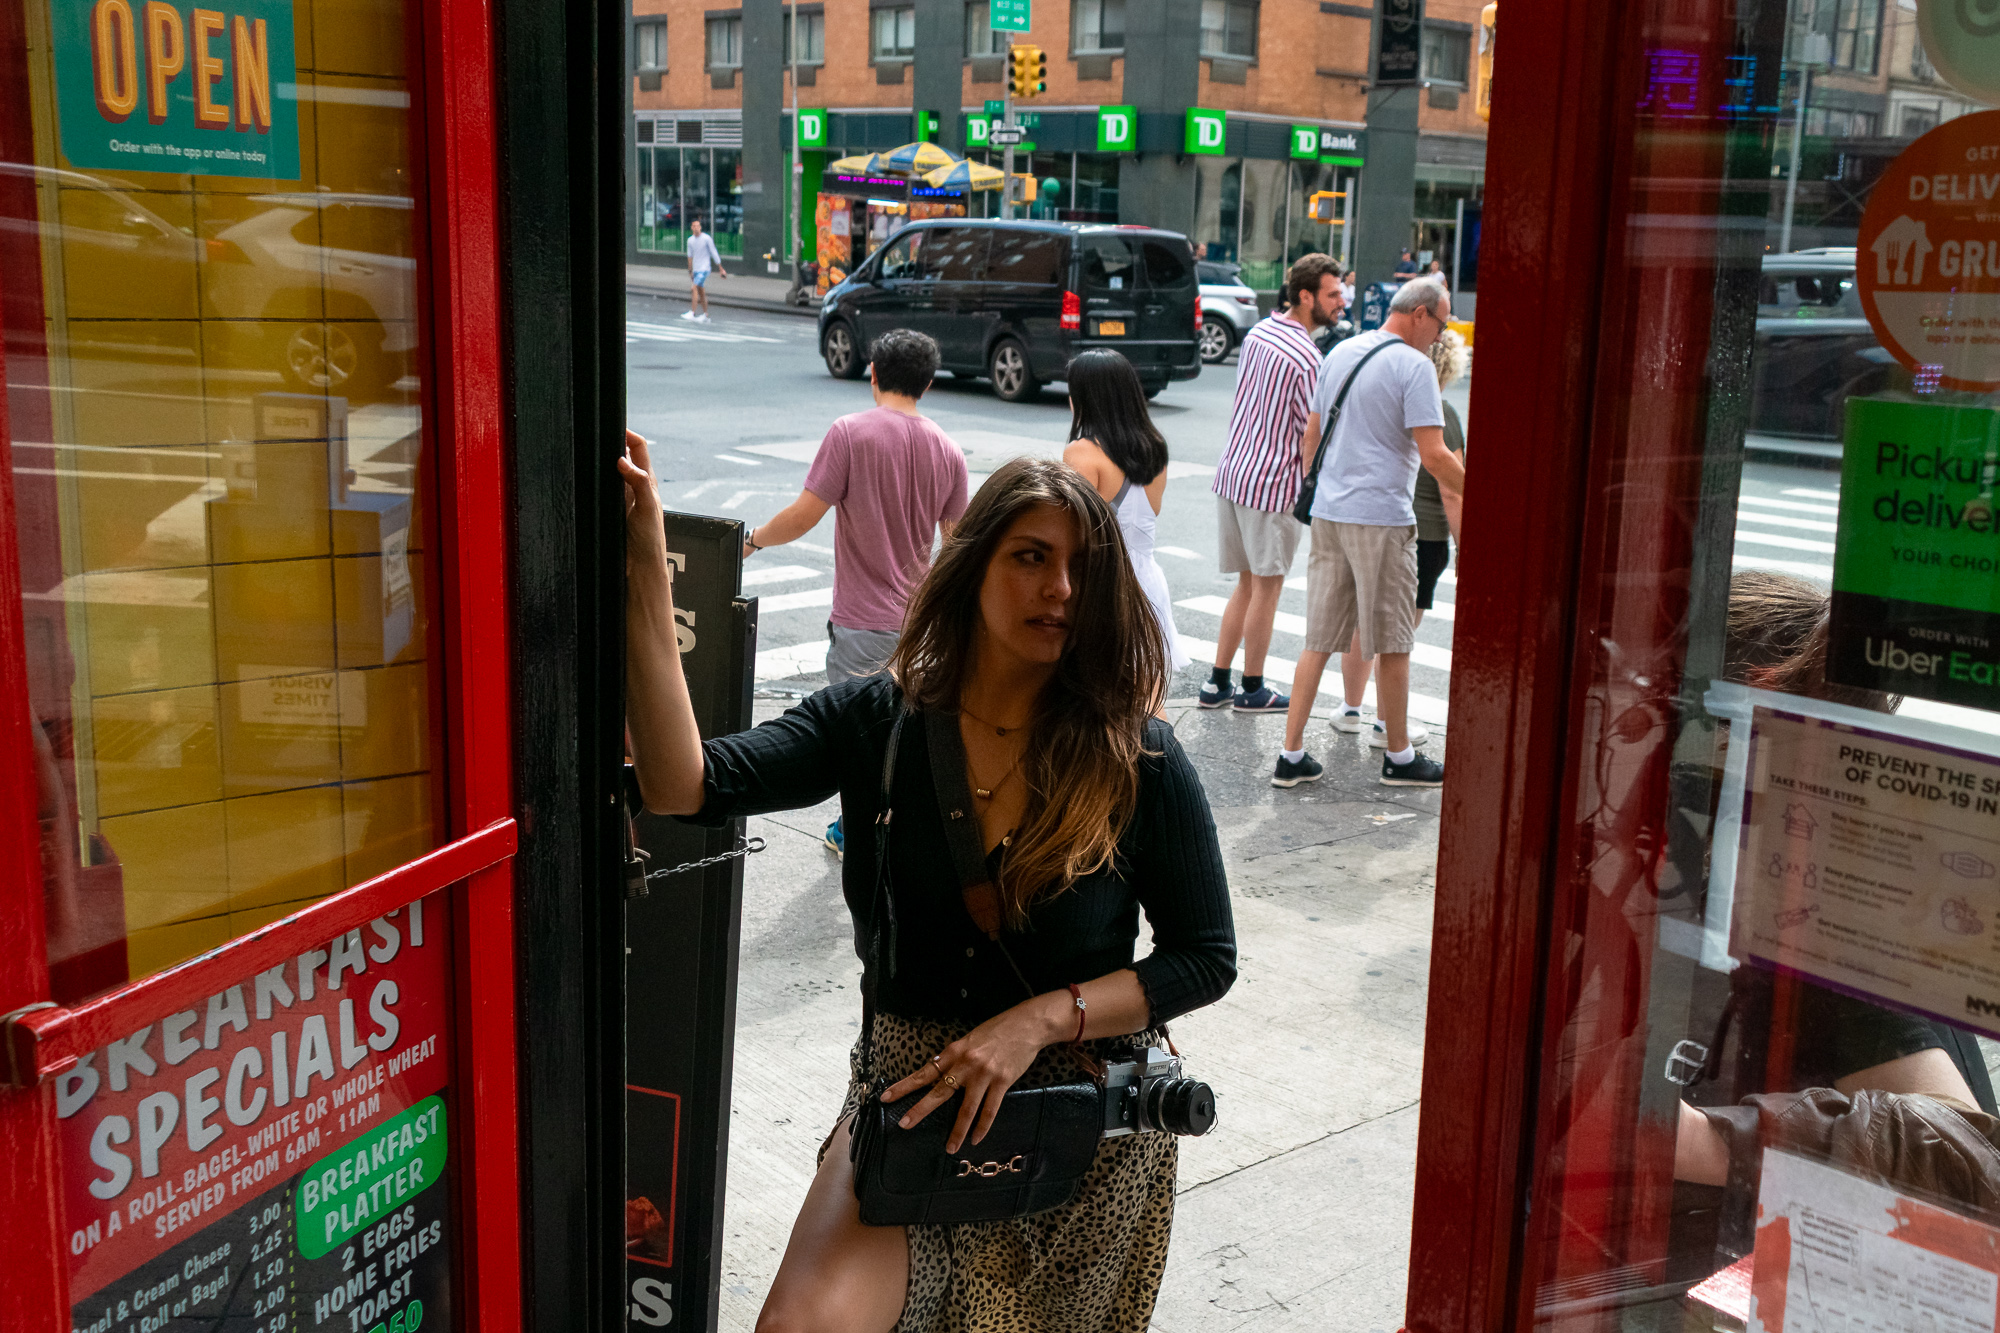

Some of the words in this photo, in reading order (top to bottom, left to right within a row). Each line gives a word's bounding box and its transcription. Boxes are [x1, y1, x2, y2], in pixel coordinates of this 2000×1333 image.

[91, 0, 271, 135] OPEN
[800, 115, 820, 140] TD
[968, 118, 988, 141] TD
[1101, 114, 1128, 143] TD
[1194, 116, 1223, 147] TD
[1295, 130, 1316, 153] TD
[1321, 132, 1357, 151] Bank
[109, 139, 140, 154] Order
[142, 143, 164, 155] with
[166, 144, 181, 157] the
[183, 147, 201, 160] app
[203, 149, 214, 159] or
[215, 148, 240, 161] online
[242, 151, 267, 165] today
[1966, 146, 1999, 162] GET
[1891, 546, 1941, 565] YOUR
[1865, 636, 1943, 676] Uber
[1908, 627, 1951, 642] ORDER
[1955, 633, 1989, 648] WITH
[1769, 774, 1795, 788] TAKE
[1798, 780, 1832, 797] THESE
[1838, 745, 1931, 778] PREVENT
[1936, 766, 1977, 790] THE
[1845, 767, 1873, 785] OF
[1877, 774, 1971, 808] COVID-19
[1975, 797, 1997, 816] IN
[88, 980, 399, 1199] SPECIALS
[71, 1220, 101, 1256] ON
[108, 1210, 123, 1238] A
[129, 1111, 300, 1225] ROLL-BAGEL-WHITE
[305, 1096, 328, 1125] OR
[332, 1064, 385, 1109] WHOLE
[388, 1034, 437, 1078] WHEAT
[303, 1105, 440, 1214] BREAKFAST
[155, 1182, 226, 1239] SERVED
[232, 1150, 280, 1196] FROM
[285, 1126, 321, 1164] 6AM
[338, 1093, 381, 1133] 11AM
[250, 1202, 282, 1236] 3.00
[324, 1157, 424, 1244] PLATTER
[251, 1229, 283, 1263] 2.25
[341, 1246, 356, 1273] 2
[363, 1205, 415, 1259] EGGS
[117, 1300, 130, 1322] &
[133, 1273, 180, 1312] Cream
[184, 1242, 231, 1281] Cheese
[253, 1257, 285, 1290] 1.50
[315, 1262, 378, 1325] HOME
[384, 1220, 442, 1278] FRIES
[140, 1303, 169, 1333] Roll
[173, 1298, 188, 1317] or
[191, 1266, 229, 1306] Bagel
[254, 1285, 286, 1319] 2.00
[348, 1269, 413, 1333] TOAST
